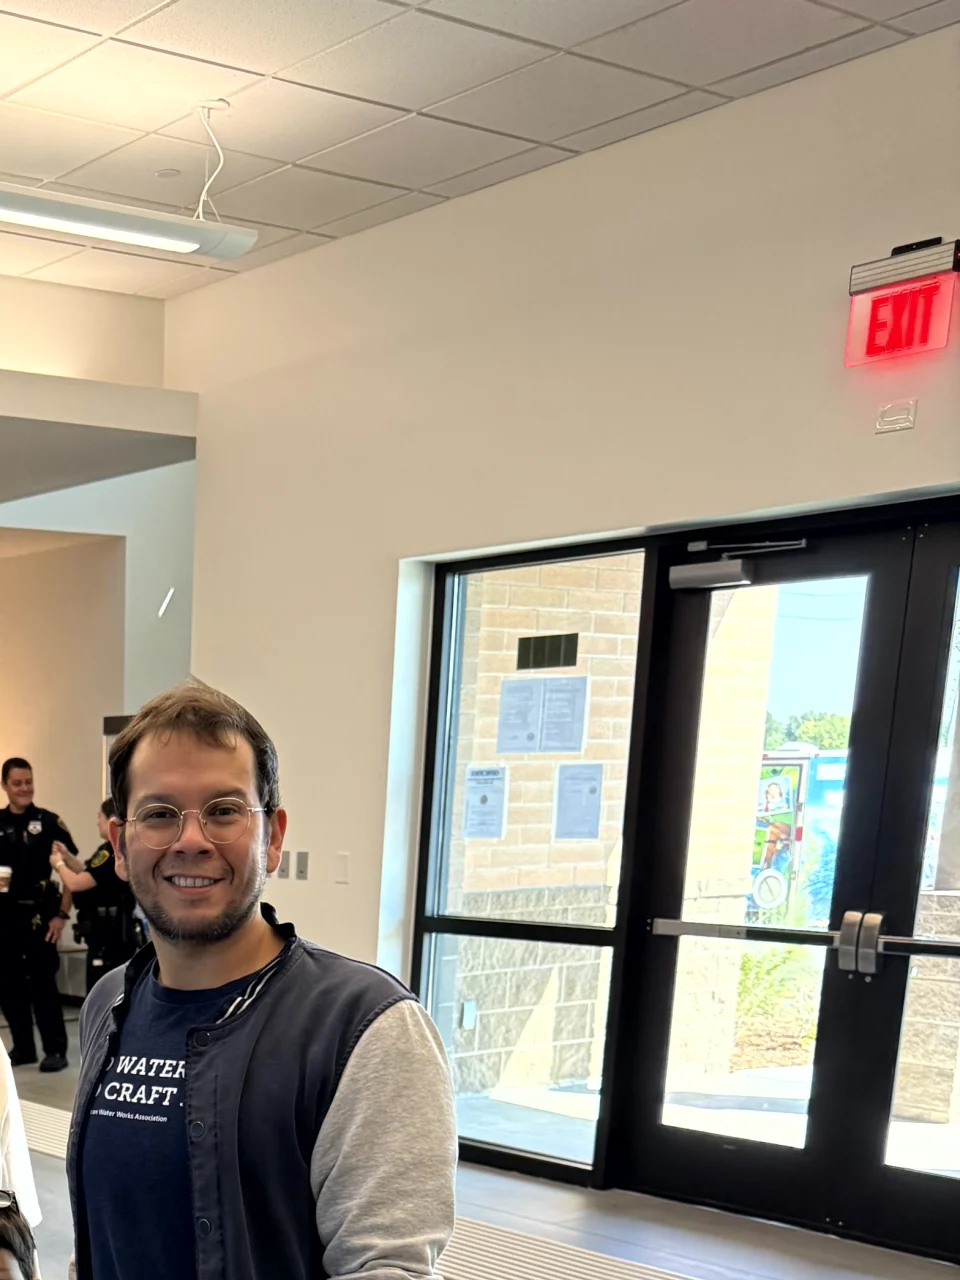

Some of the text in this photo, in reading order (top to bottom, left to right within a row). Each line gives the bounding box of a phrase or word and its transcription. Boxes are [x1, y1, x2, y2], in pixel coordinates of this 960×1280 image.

[865, 282, 940, 357] EXIT
[98, 1109, 115, 1117] Water
[116, 1111, 134, 1120] Works
[134, 1113, 168, 1123] Association
